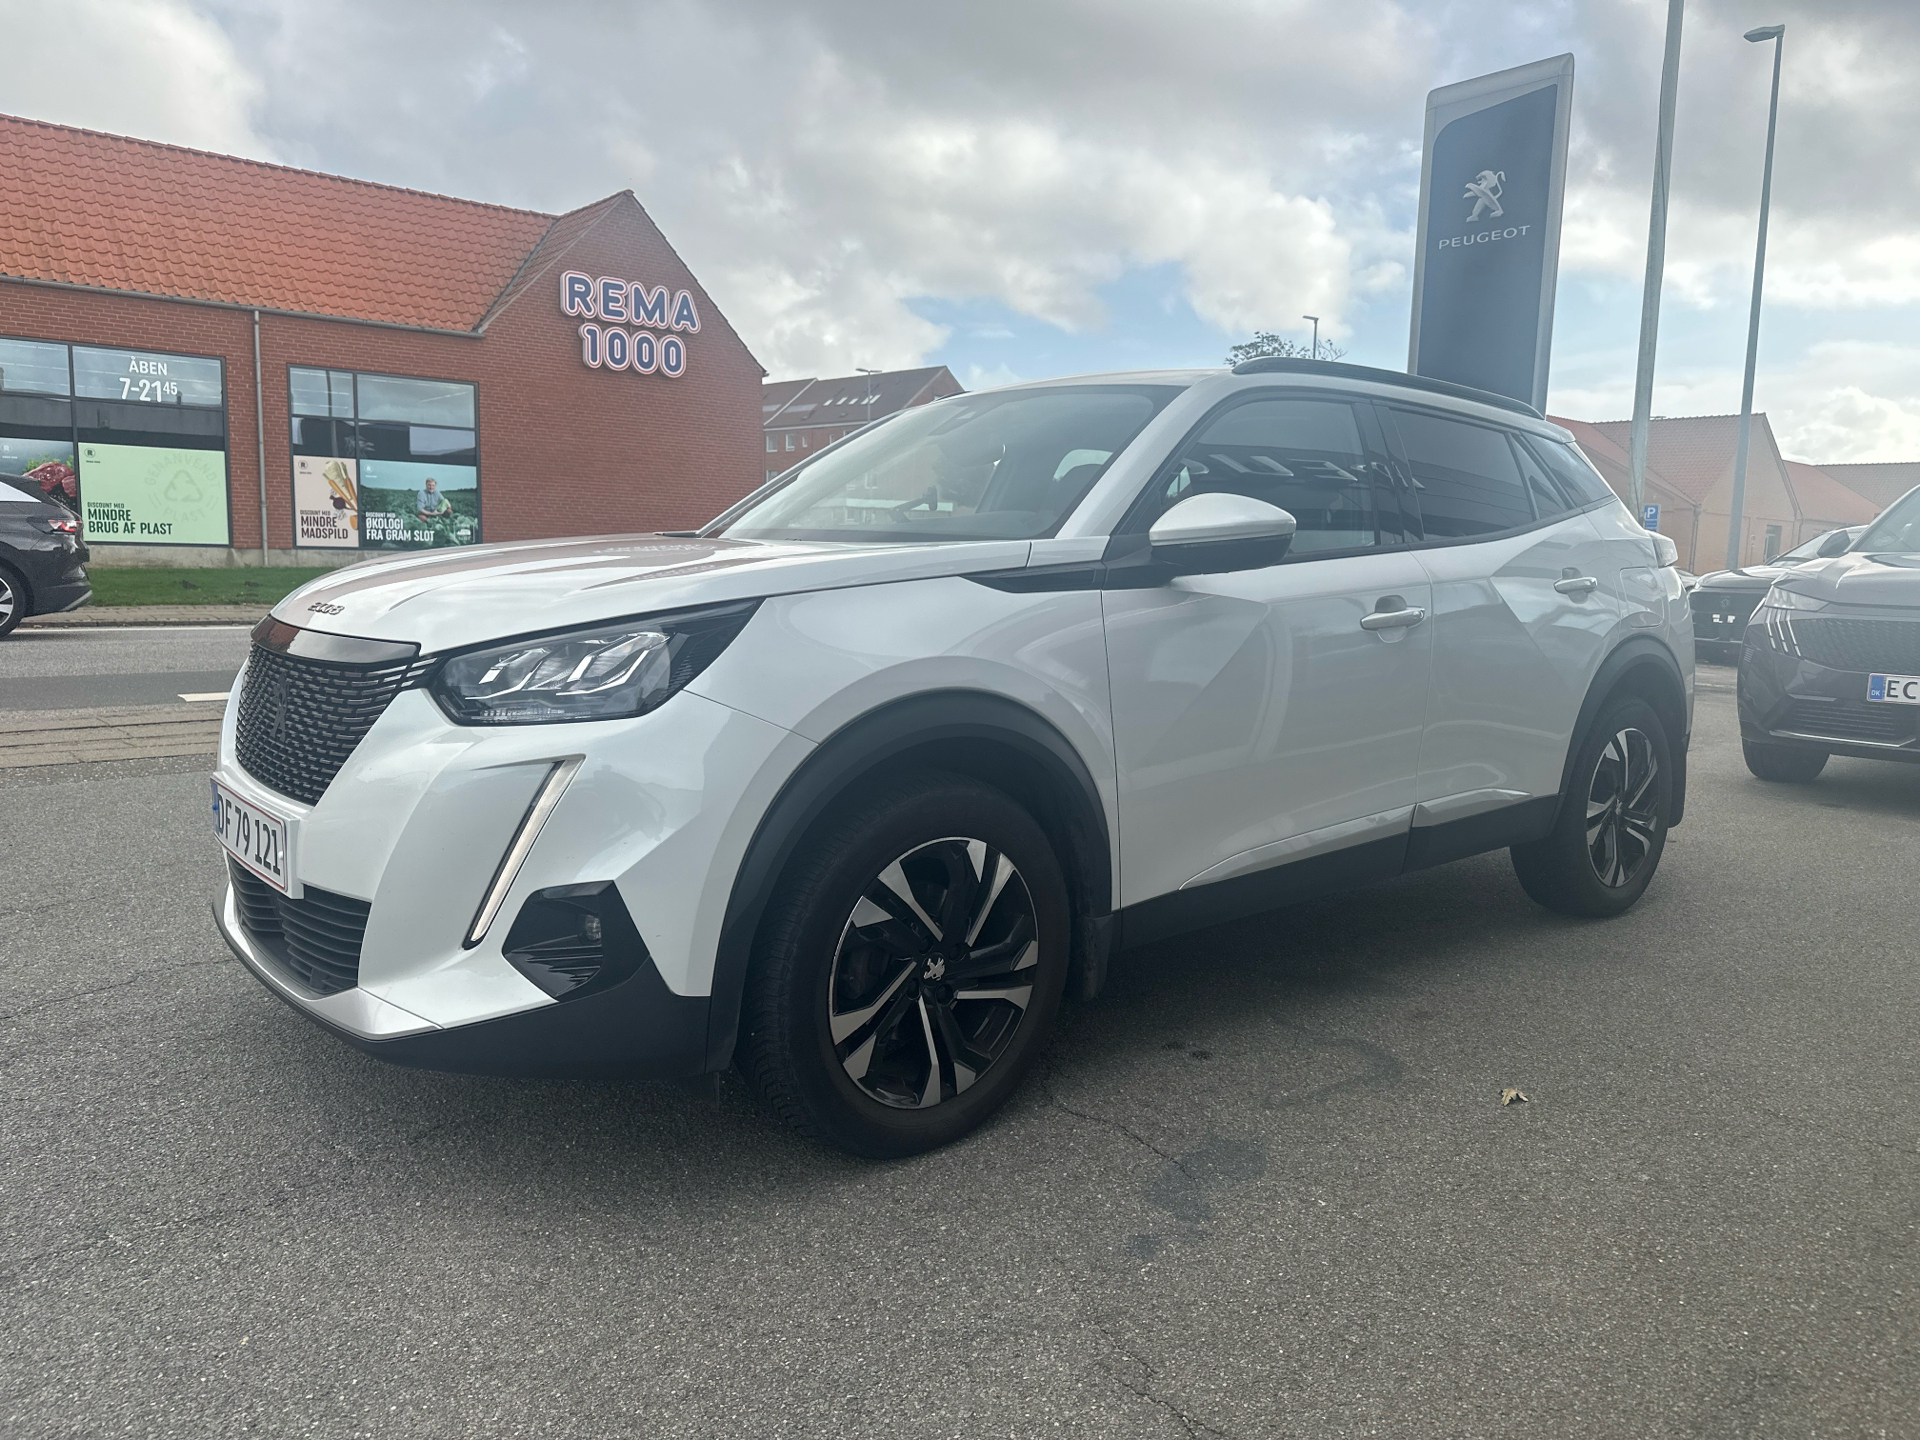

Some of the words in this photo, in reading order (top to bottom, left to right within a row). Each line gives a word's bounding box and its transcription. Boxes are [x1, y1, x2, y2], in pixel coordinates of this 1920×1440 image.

[1438, 225, 1531, 250] PEUGEOT
[560, 270, 701, 334] REMA
[578, 322, 687, 378] 1000
[128, 355, 168, 376] ÅBEN
[88, 508, 131, 522] MINDRE
[1647, 507, 1656, 518] P
[88, 521, 119, 534] BRUG
[123, 522, 136, 534] AF
[140, 523, 173, 535] PLAST
[300, 515, 337, 528] MINDRE
[366, 518, 404, 530] ØKOLOGI
[301, 528, 348, 539] MADSPILD
[366, 530, 383, 541] FRA
[386, 530, 411, 541] GRAM
[413, 531, 435, 542] SLOT
[1871, 689, 1881, 697] DK
[1886, 679, 1918, 700] EC
[217, 793, 232, 840] DF
[234, 805, 251, 856] 79
[254, 819, 281, 877] 121
